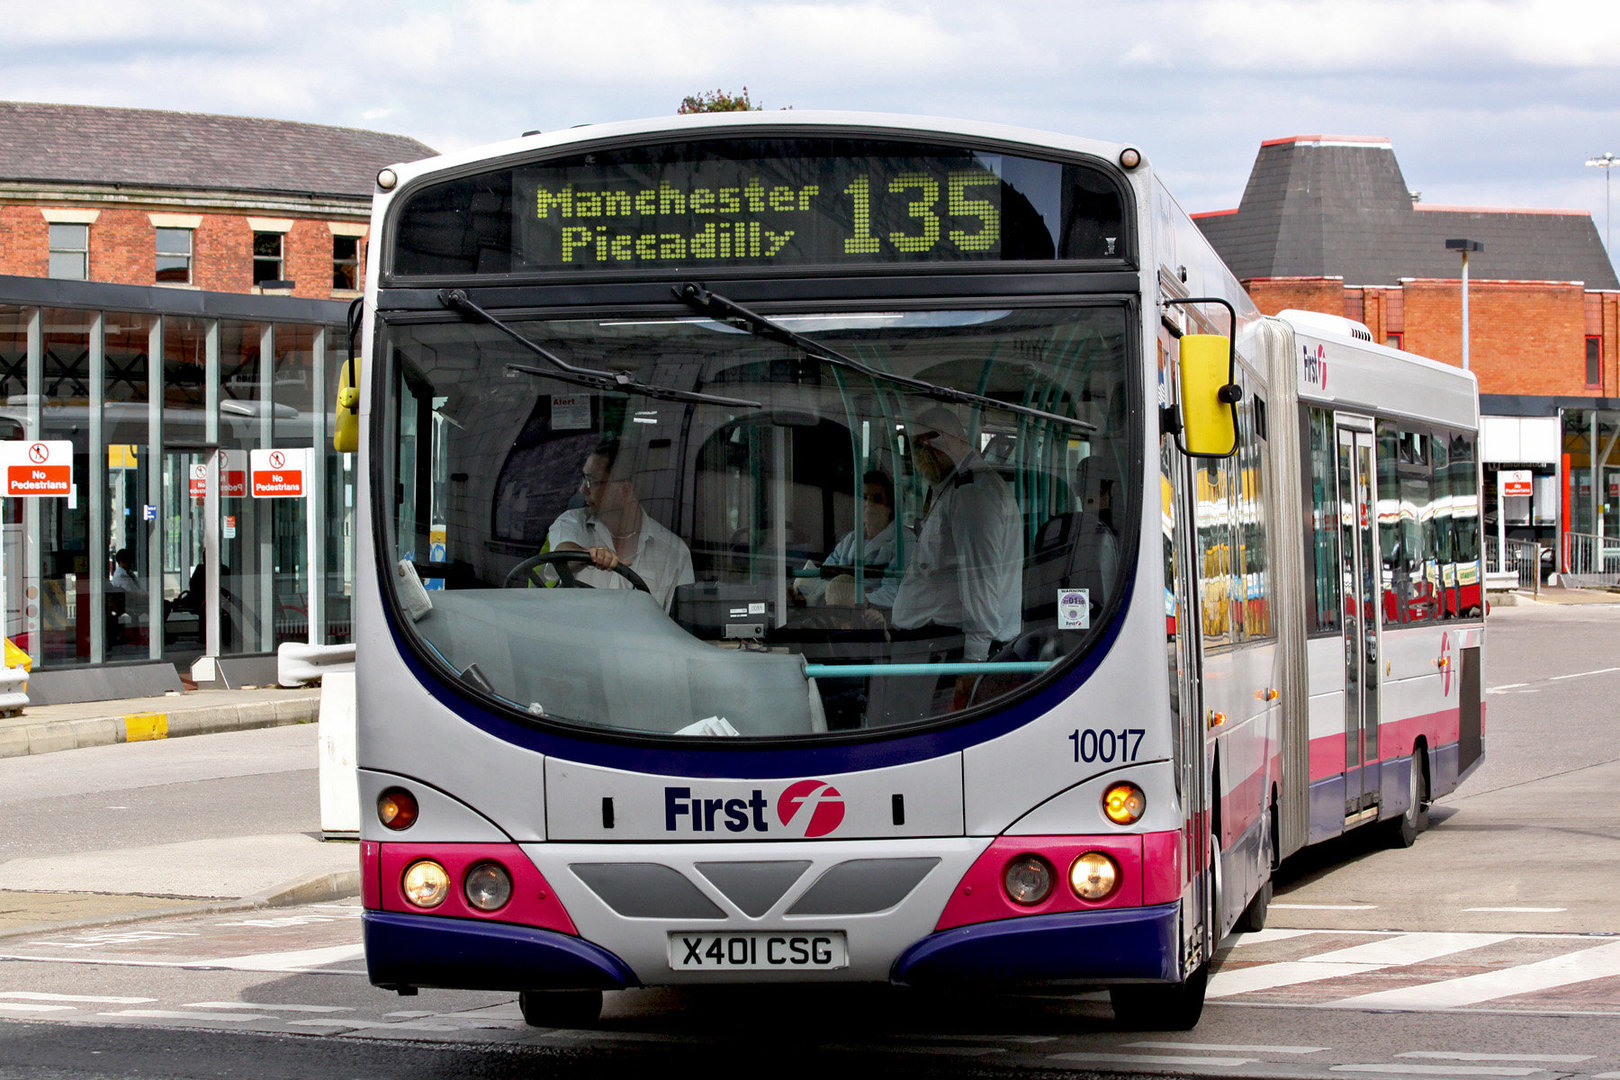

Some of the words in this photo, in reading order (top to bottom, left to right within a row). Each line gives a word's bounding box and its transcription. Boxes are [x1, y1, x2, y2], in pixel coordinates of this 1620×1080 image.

[537, 177, 819, 218] Manchester
[844, 173, 999, 253] 135
[562, 222, 795, 262] Piccadilly
[1303, 344, 1318, 384] First
[11, 480, 68, 490] Pedestrians
[32, 470, 46, 480] No
[256, 483, 300, 491] Pedestrians
[272, 474, 283, 482] No
[1068, 729, 1146, 763] 10017
[664, 786, 768, 832] First
[682, 938, 757, 965] X401
[767, 938, 832, 965] CSG
